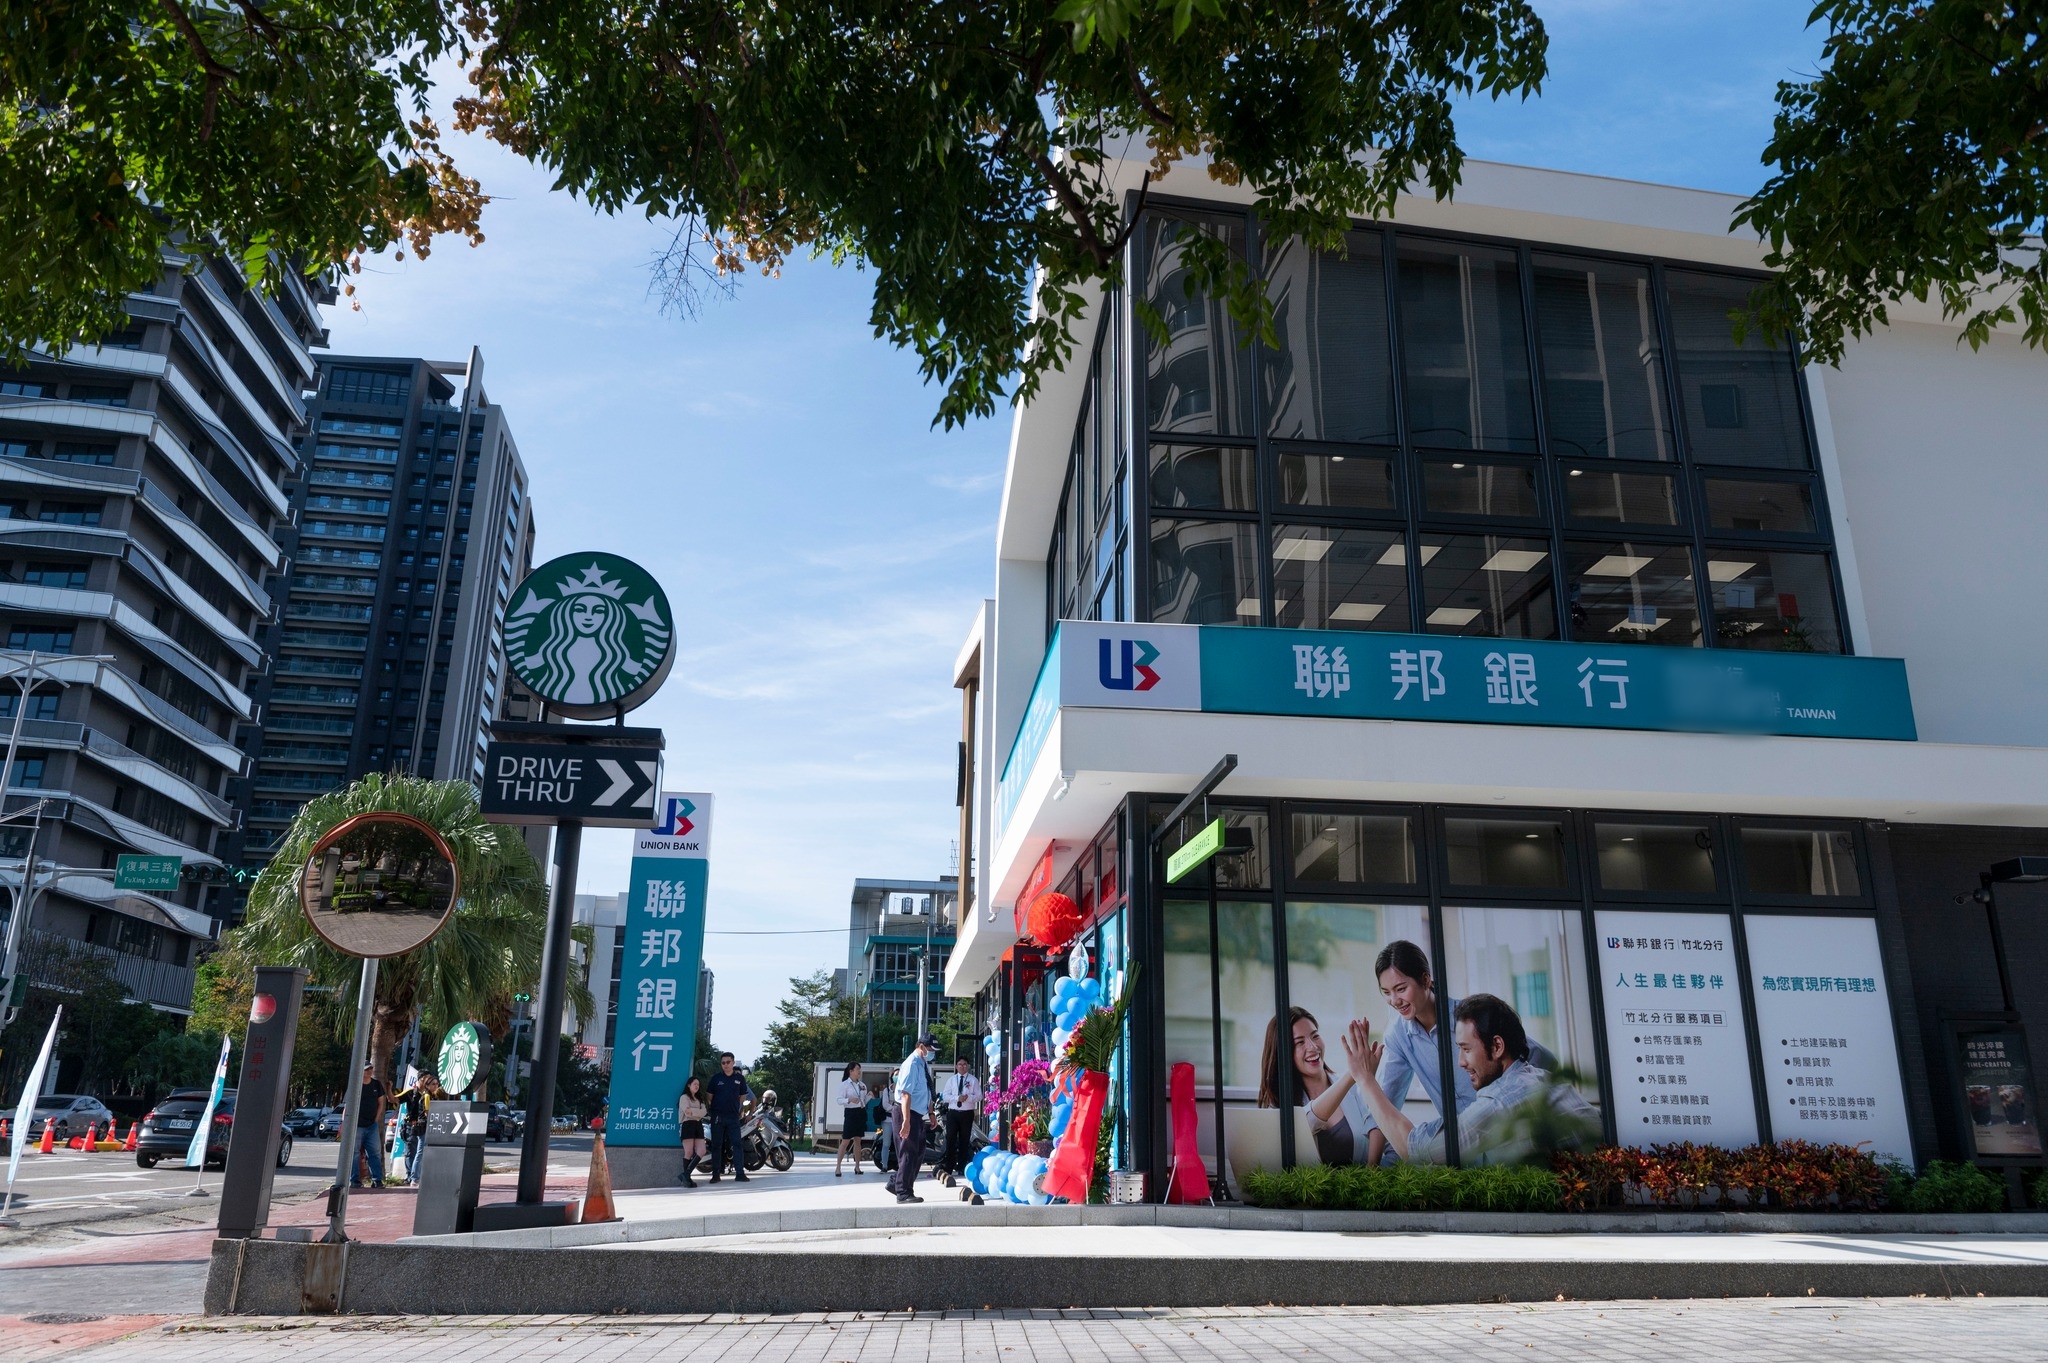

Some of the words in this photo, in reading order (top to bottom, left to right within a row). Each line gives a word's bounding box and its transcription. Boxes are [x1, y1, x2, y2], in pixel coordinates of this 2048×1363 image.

[1292, 644, 1630, 709] 聯邦銀行
[1786, 707, 1837, 720] TAIWAN
[497, 756, 583, 780] DRIVE
[497, 779, 575, 803] THRU
[640, 841, 671, 851] UNION
[673, 842, 700, 851] BANK
[126, 861, 173, 873] 復興三路
[124, 877, 146, 885] FuXing
[1622, 937, 1674, 950] 聯邦銀行
[1681, 939, 1723, 951] 竹北分行
[631, 879, 687, 1072] 聯邦銀行
[1615, 973, 1724, 989] 人生最佳夥伴
[1762, 975, 1877, 993] 為您實現所有理想
[1625, 1012, 1723, 1024] 竹北分行服務項目
[1643, 1035, 1703, 1046] 台幣存匯業務
[249, 1037, 267, 1080] 出車中
[1645, 1054, 1685, 1065] 財富管理
[1792, 1057, 1832, 1067] 房屋貸款
[1647, 1074, 1687, 1085] 外匯業務
[1795, 1076, 1834, 1087] 信用貸款
[429, 1113, 451, 1123] DRIVE
[619, 1107, 674, 1120] 竹北分行
[429, 1124, 448, 1134] THRU
[614, 1122, 643, 1130] ZHUBEI
